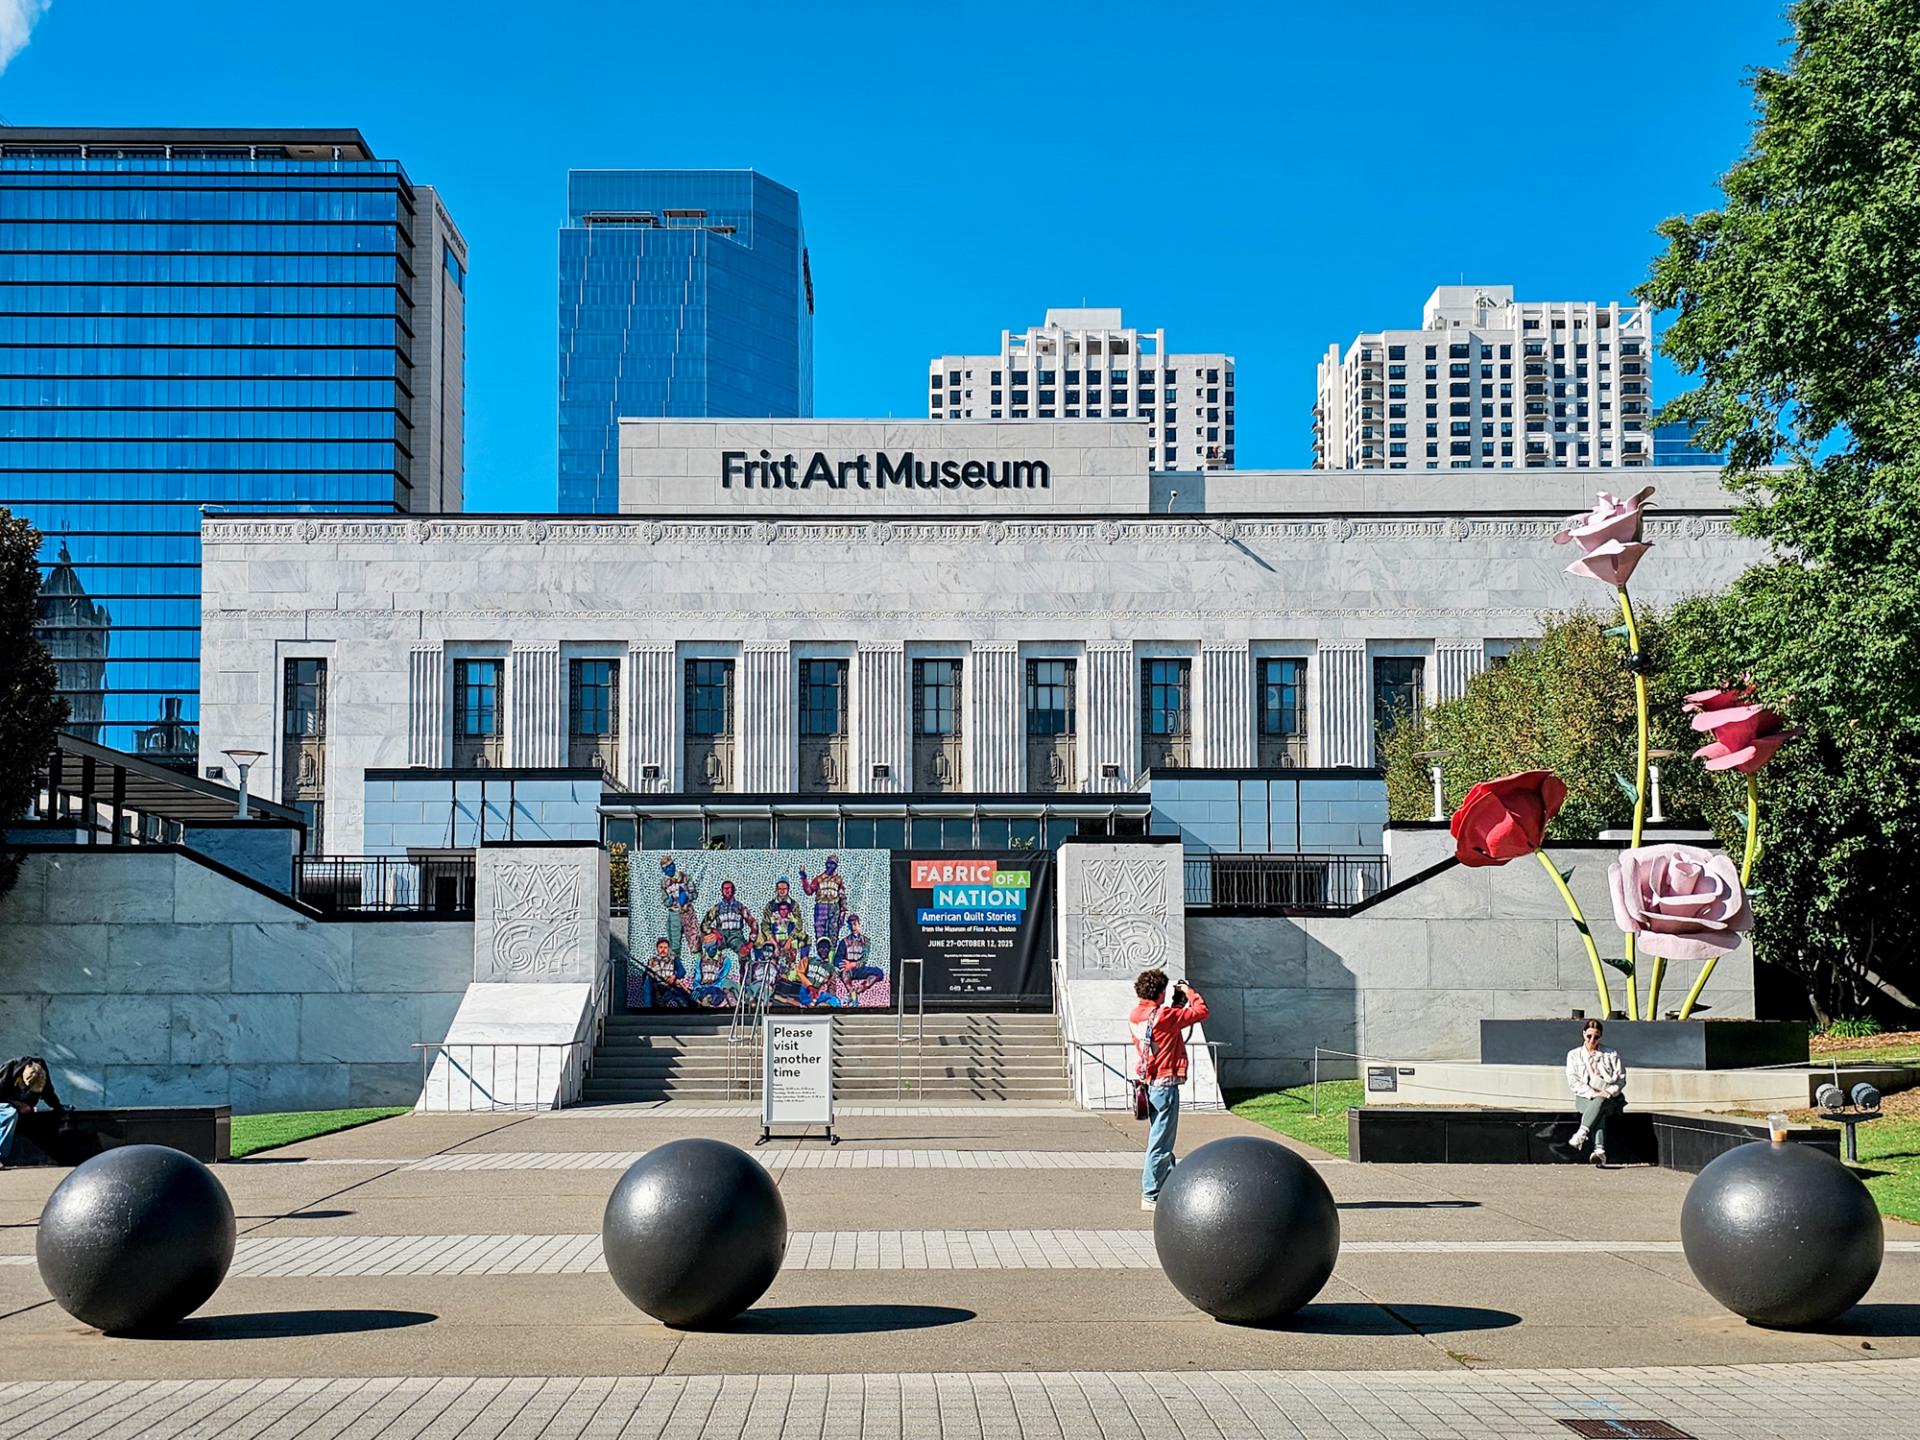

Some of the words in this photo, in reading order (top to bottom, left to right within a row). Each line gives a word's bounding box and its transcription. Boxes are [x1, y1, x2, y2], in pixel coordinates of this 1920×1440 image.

[721, 450, 798, 489] Frist
[800, 452, 870, 489] Art
[876, 452, 1051, 489] Museum
[917, 866, 990, 882] FABRIC
[995, 874, 1014, 885] OF
[1017, 874, 1027, 885] A
[939, 890, 1020, 906] NATION
[922, 912, 962, 921] American
[963, 911, 985, 922] Quilt
[986, 912, 1016, 921] Stories
[928, 940, 945, 948] JUNE
[987, 940, 997, 949] 12,
[997, 940, 1014, 948] 2025
[774, 1027, 813, 1037] Please
[774, 1041, 799, 1050] visit
[774, 1053, 821, 1063] another
[774, 1067, 801, 1077] time
